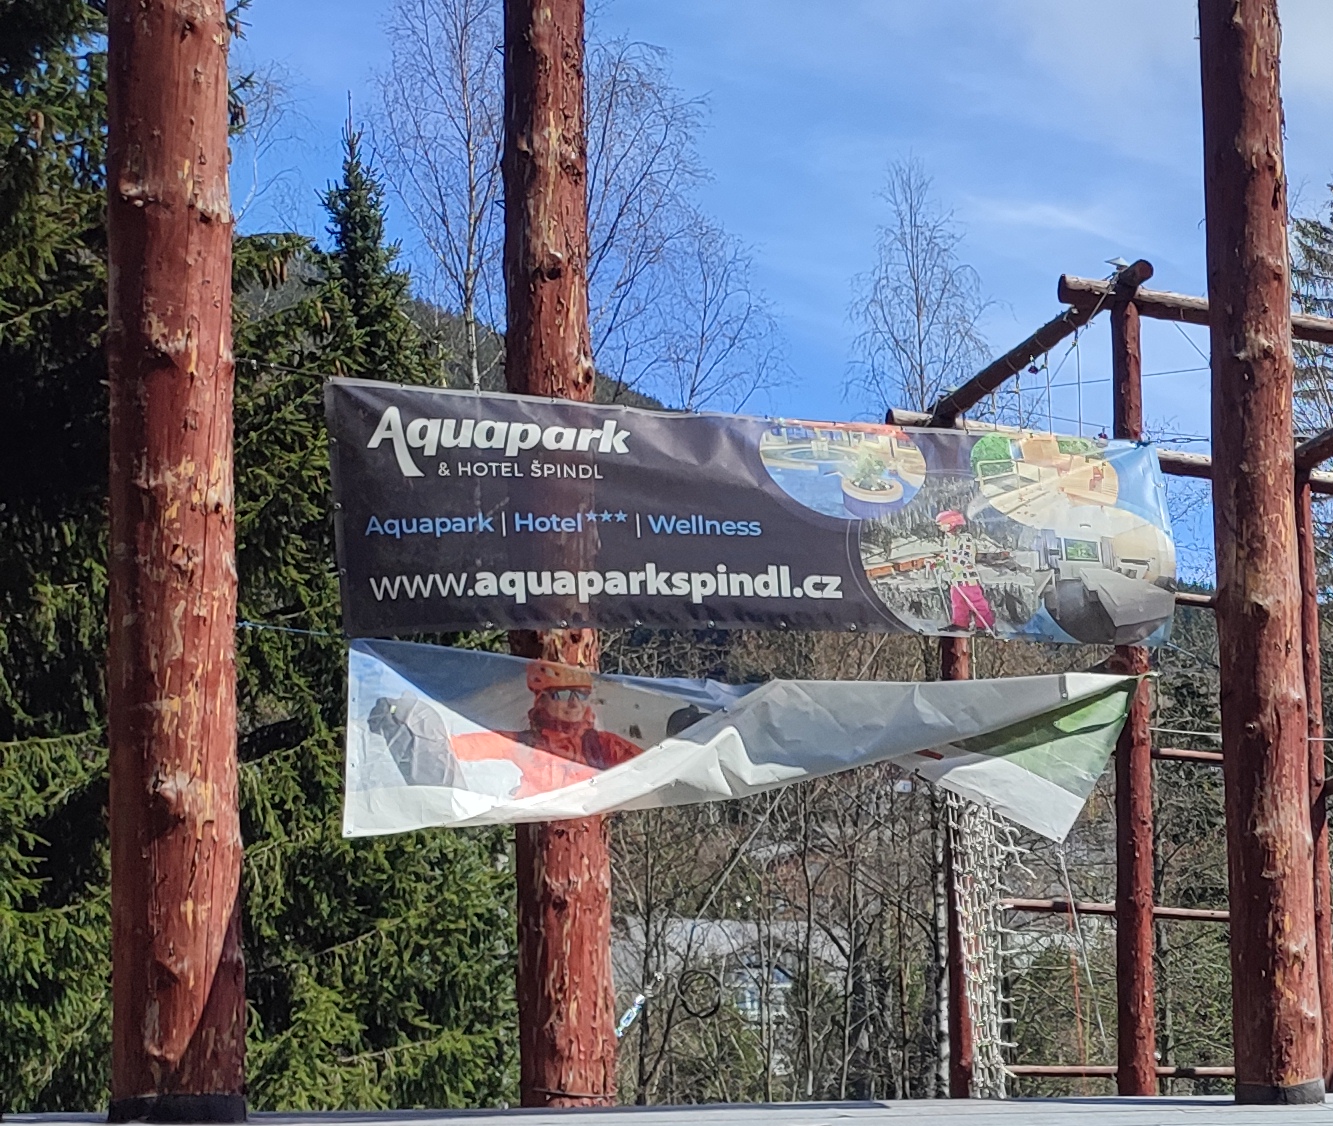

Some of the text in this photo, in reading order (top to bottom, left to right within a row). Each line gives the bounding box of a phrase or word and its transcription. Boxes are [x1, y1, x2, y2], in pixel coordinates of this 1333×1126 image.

[367, 406, 631, 477] Aquapark
[436, 460, 603, 479] & HOTEL ŠPINDL
[366, 511, 494, 538] Aquapark
[648, 514, 762, 537] Wellness
[370, 562, 843, 604] www.aquaparkspindl.cz
